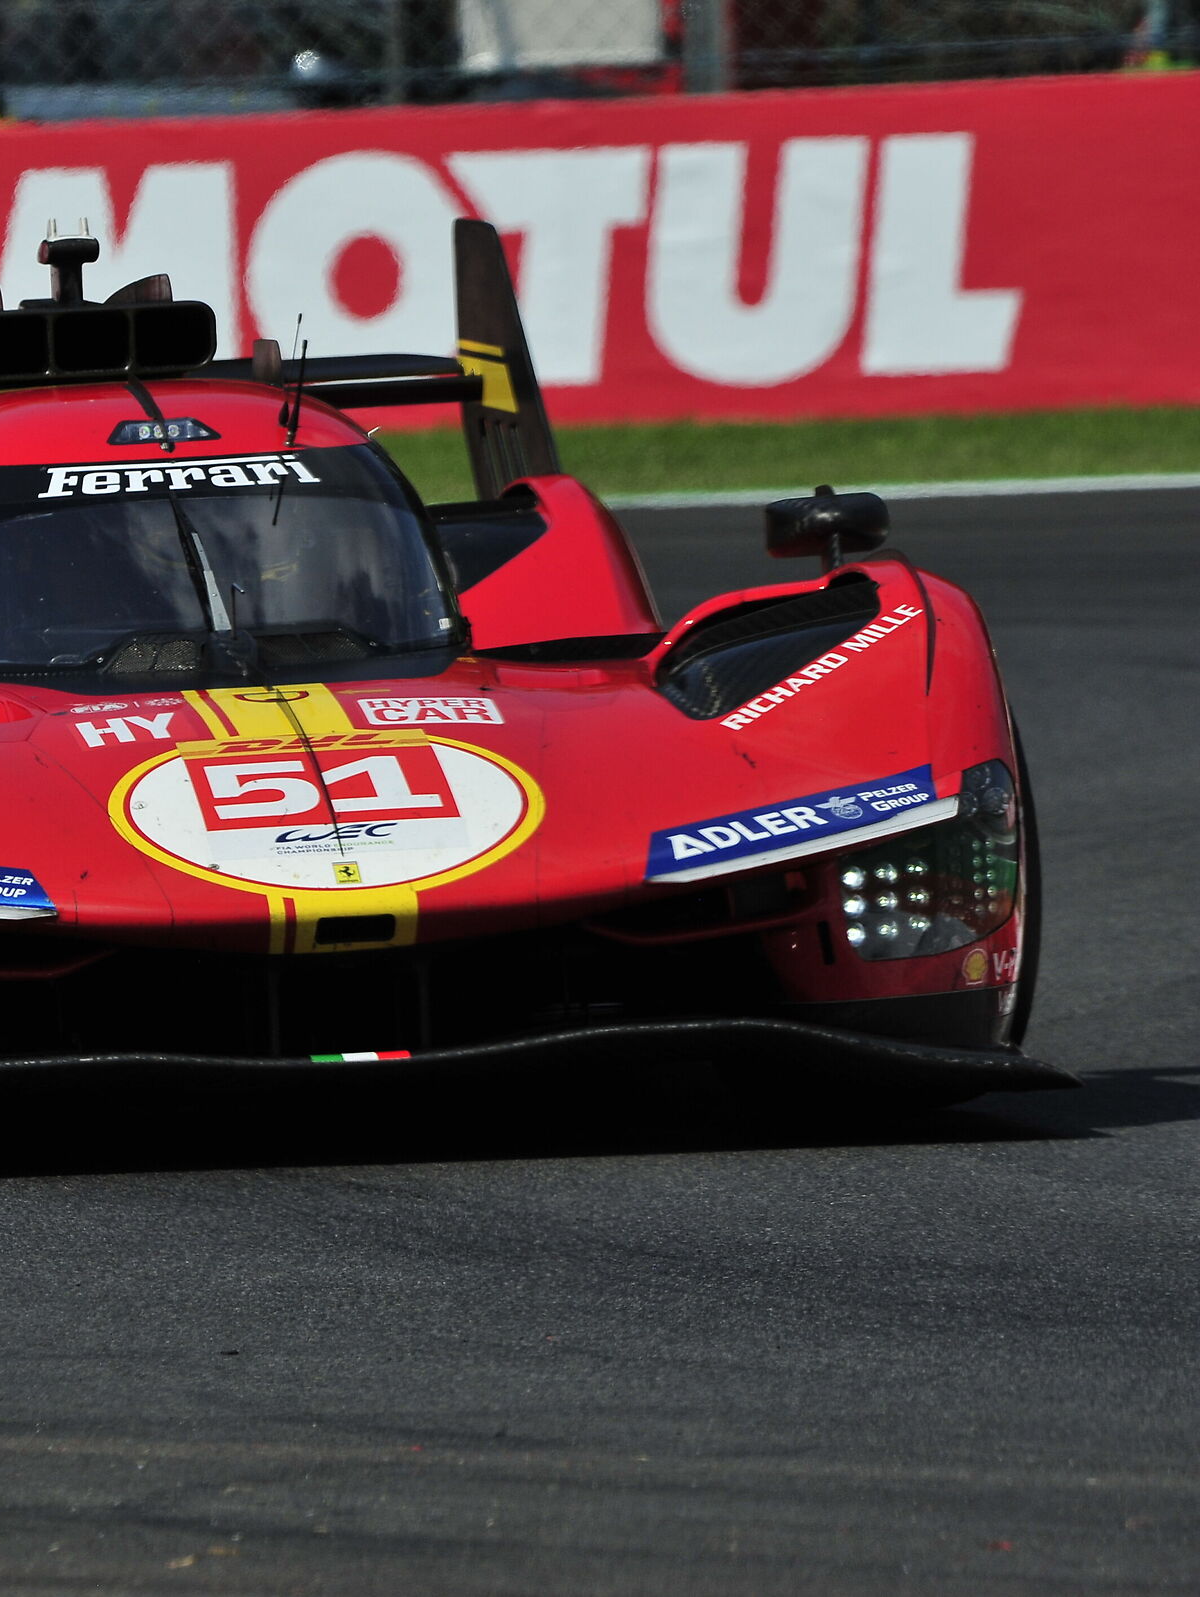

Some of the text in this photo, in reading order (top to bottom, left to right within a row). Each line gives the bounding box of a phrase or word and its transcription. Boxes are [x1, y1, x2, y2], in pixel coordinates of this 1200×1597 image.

[37, 453, 321, 499] Ferrari
[719, 603, 923, 731] RICHARD MILLE
[365, 698, 486, 709] HYPER
[372, 707, 494, 722] CAR
[74, 712, 174, 748] HY
[202, 754, 445, 821] 51
[857, 782, 918, 802] PELZER
[870, 792, 930, 812] GROUP
[275, 822, 398, 843] WEC
[666, 806, 829, 861] ADLER
